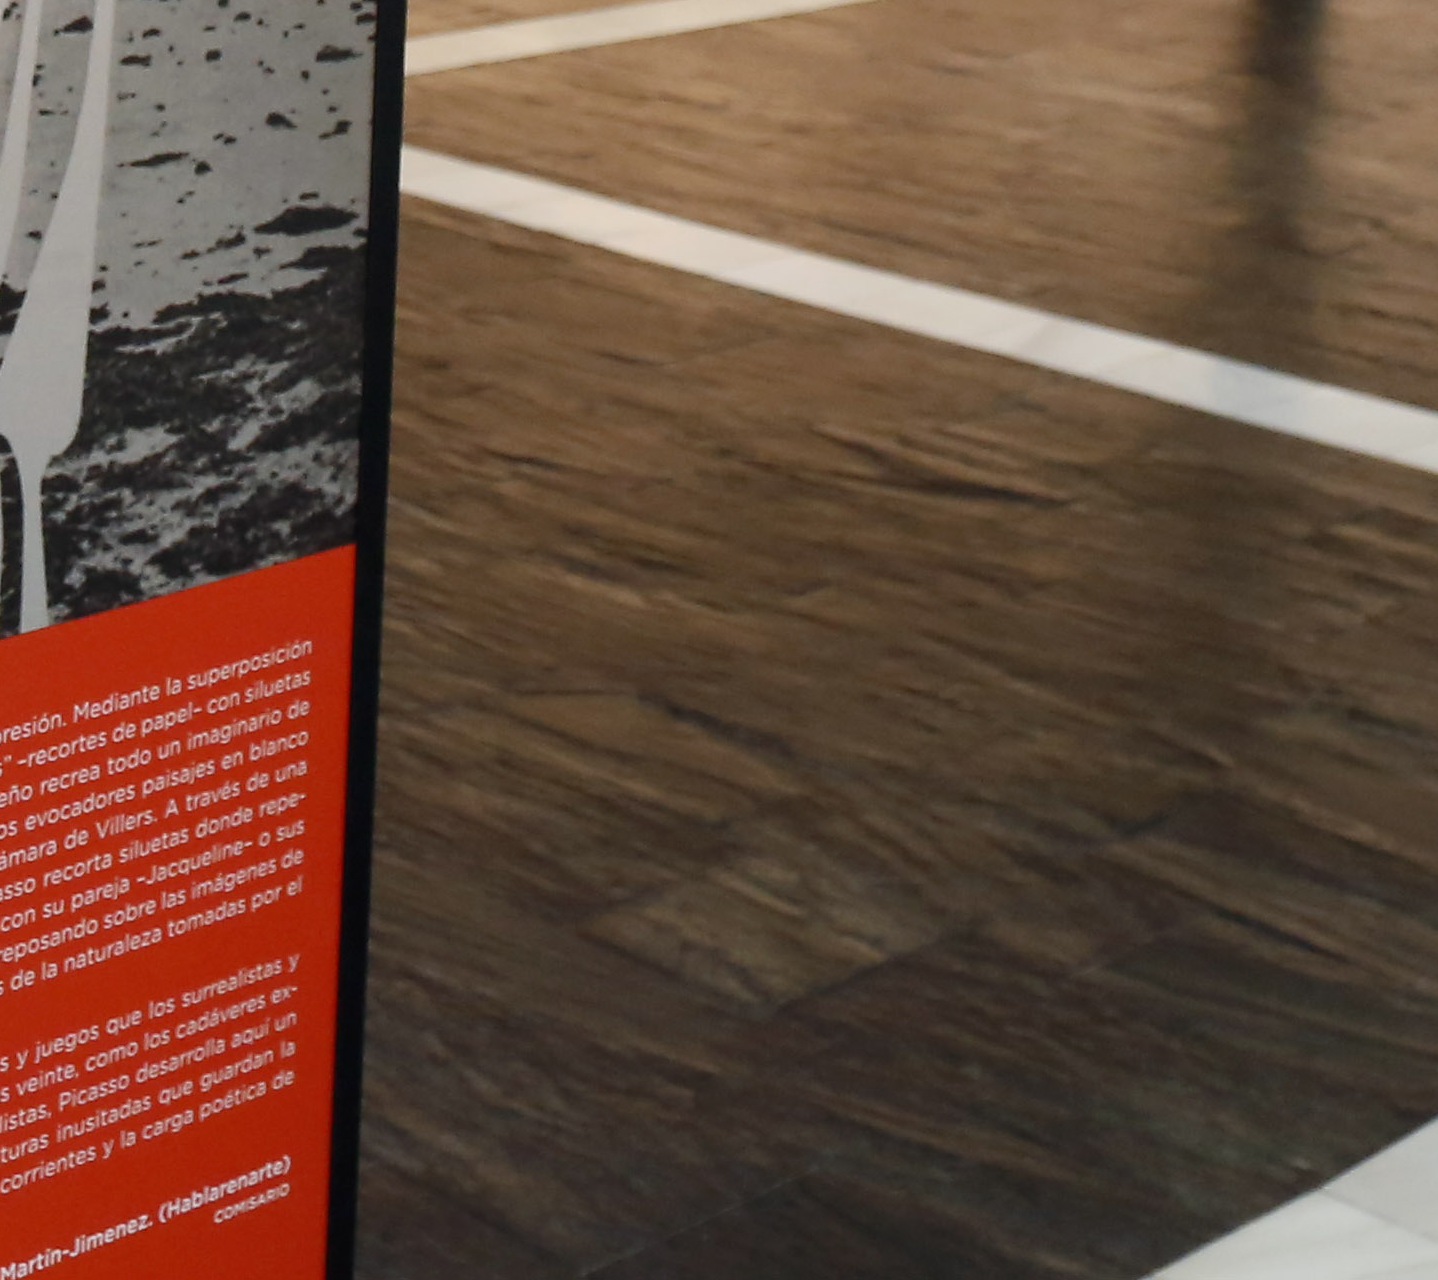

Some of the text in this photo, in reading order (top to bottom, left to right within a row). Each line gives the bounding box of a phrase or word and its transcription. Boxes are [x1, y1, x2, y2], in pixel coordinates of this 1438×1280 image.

[72, 685, 162, 724] Mediante
[165, 676, 183, 697] la
[186, 639, 313, 691] superposición
[15, 1049, 30, 1071] y
[33, 1024, 100, 1065] juegos
[104, 1009, 144, 1037] que
[148, 997, 176, 1020] los
[180, 958, 283, 1009] surrealistas
[287, 953, 300, 973] y
[101, 1069, 296, 1160] y la carga poética de
[212, 1182, 291, 1225] COMISARIO
